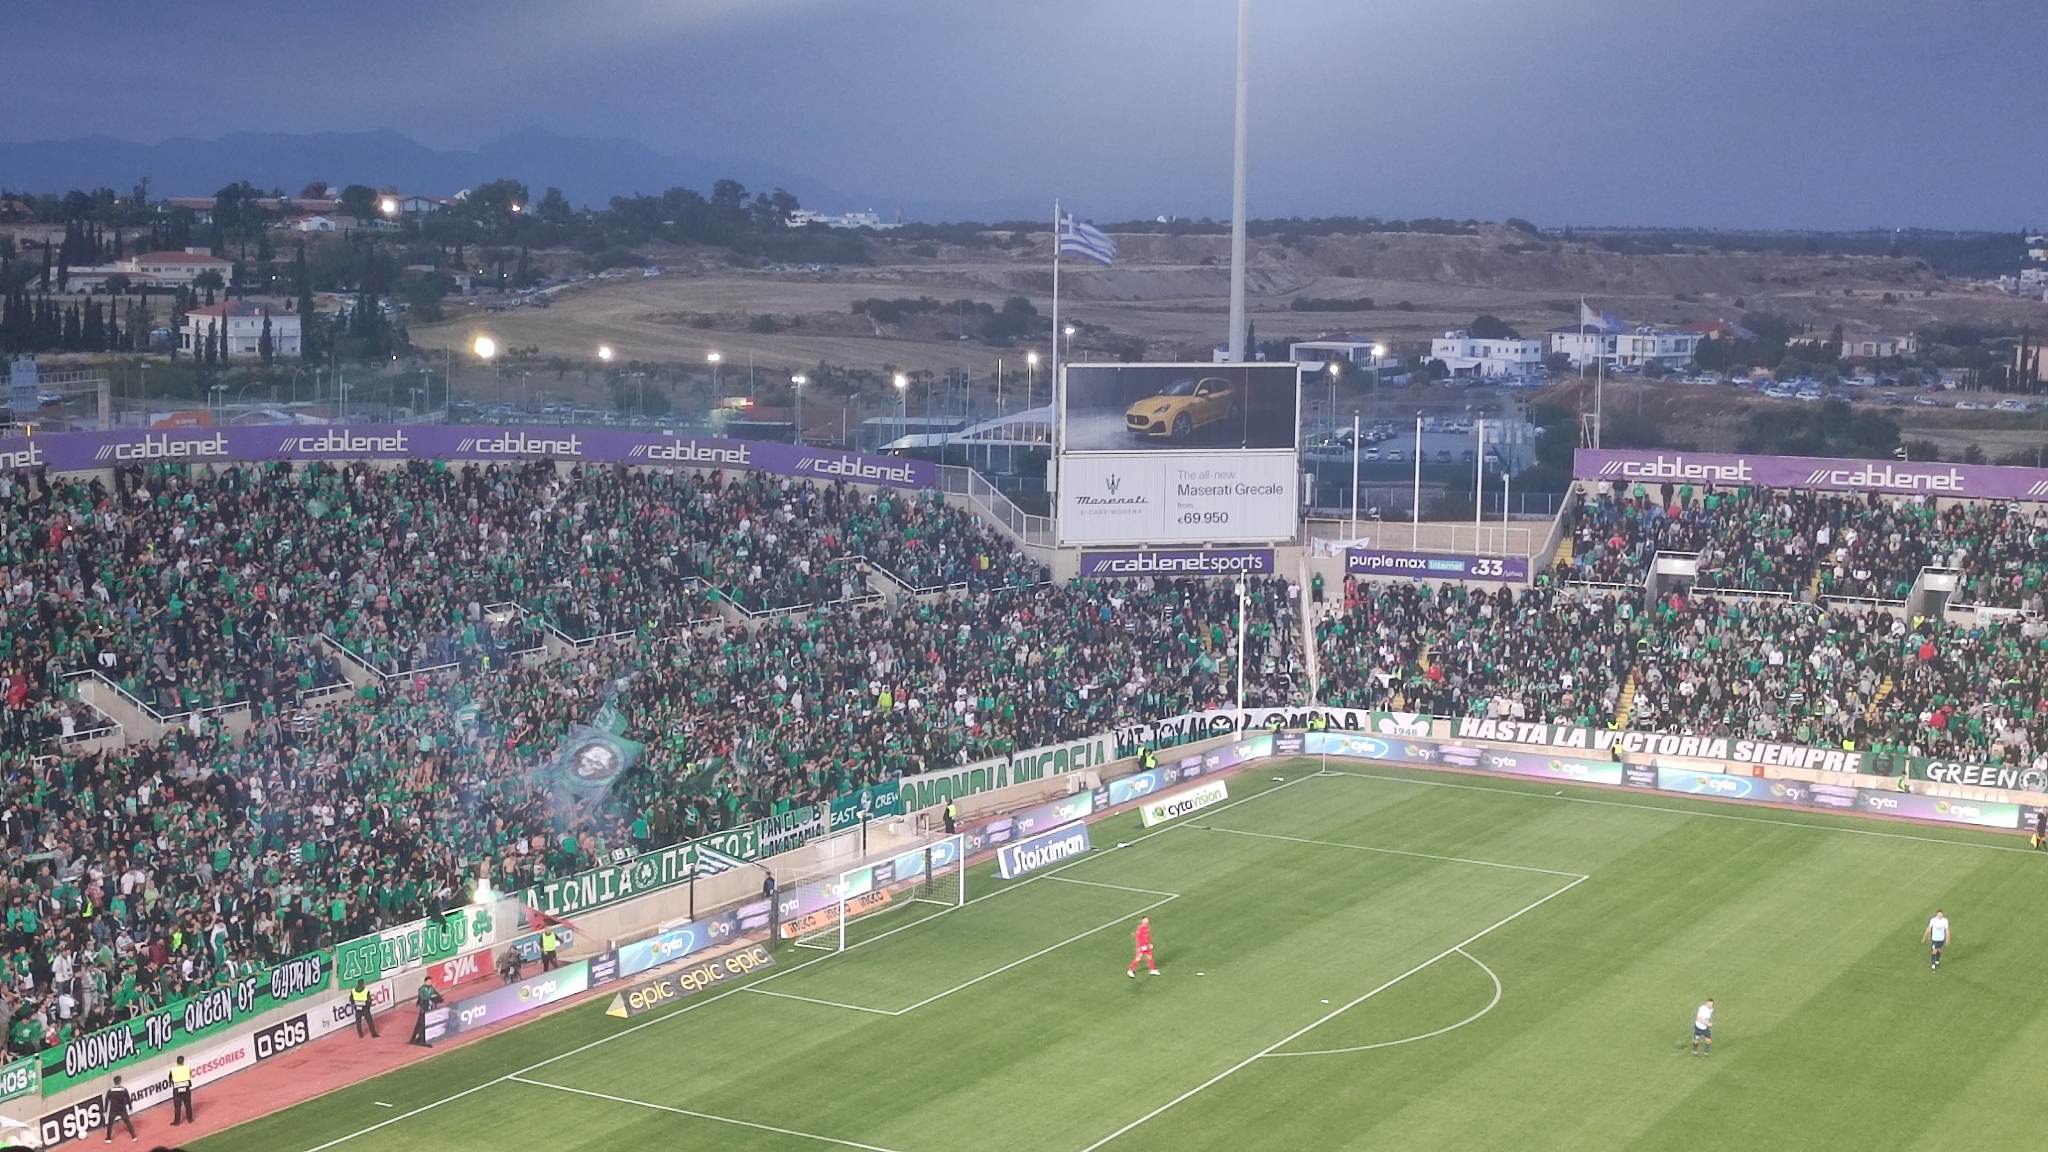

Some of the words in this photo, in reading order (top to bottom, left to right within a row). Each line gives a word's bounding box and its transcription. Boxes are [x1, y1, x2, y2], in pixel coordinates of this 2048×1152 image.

[0, 441, 43, 469] net
[115, 432, 228, 459] cablenet
[298, 430, 408, 454] cablenet
[476, 432, 582, 456] cablenet
[647, 440, 751, 465] cablenet
[814, 455, 916, 484] cablenet
[1177, 470, 1196, 480] The
[1623, 456, 1752, 481] cablenet
[1830, 464, 1964, 491] cablenet
[1177, 484, 1232, 496] Maserati
[1235, 483, 1284, 496] Grecale
[1350, 555, 1394, 571] purple
[1396, 558, 1427, 569] max
[1351, 741, 1376, 753] cyta
[1459, 717, 1549, 746] HASTA
[1552, 727, 1590, 749] LA
[1594, 730, 1728, 759] VICTORIA
[1733, 741, 1862, 773] SIEMPRE
[1492, 756, 1516, 768] cyta
[1926, 762, 2018, 789] GREEN
[830, 805, 858, 826] EAST
[875, 791, 901, 808] CREW
[1870, 797, 1898, 809] cyta
[761, 817, 782, 840] FAN
[662, 831, 756, 882] ΠΙΤΟΙ
[1012, 834, 1084, 875] Stoiximan
[343, 919, 469, 981] ATHIENOU
[443, 955, 478, 984] SYM
[629, 980, 674, 1009] epic
[680, 963, 724, 990] epic
[725, 948, 769, 973] epic
[185, 990, 233, 1031] QUEEN
[239, 978, 256, 1011] OF
[271, 957, 322, 1000] CYPRUS
[532, 980, 557, 1000] cyta
[461, 1004, 487, 1024] cyta
[274, 1021, 306, 1053] sbs
[190, 1048, 246, 1078] CCESSORIES
[63, 1103, 101, 1138] sbs
